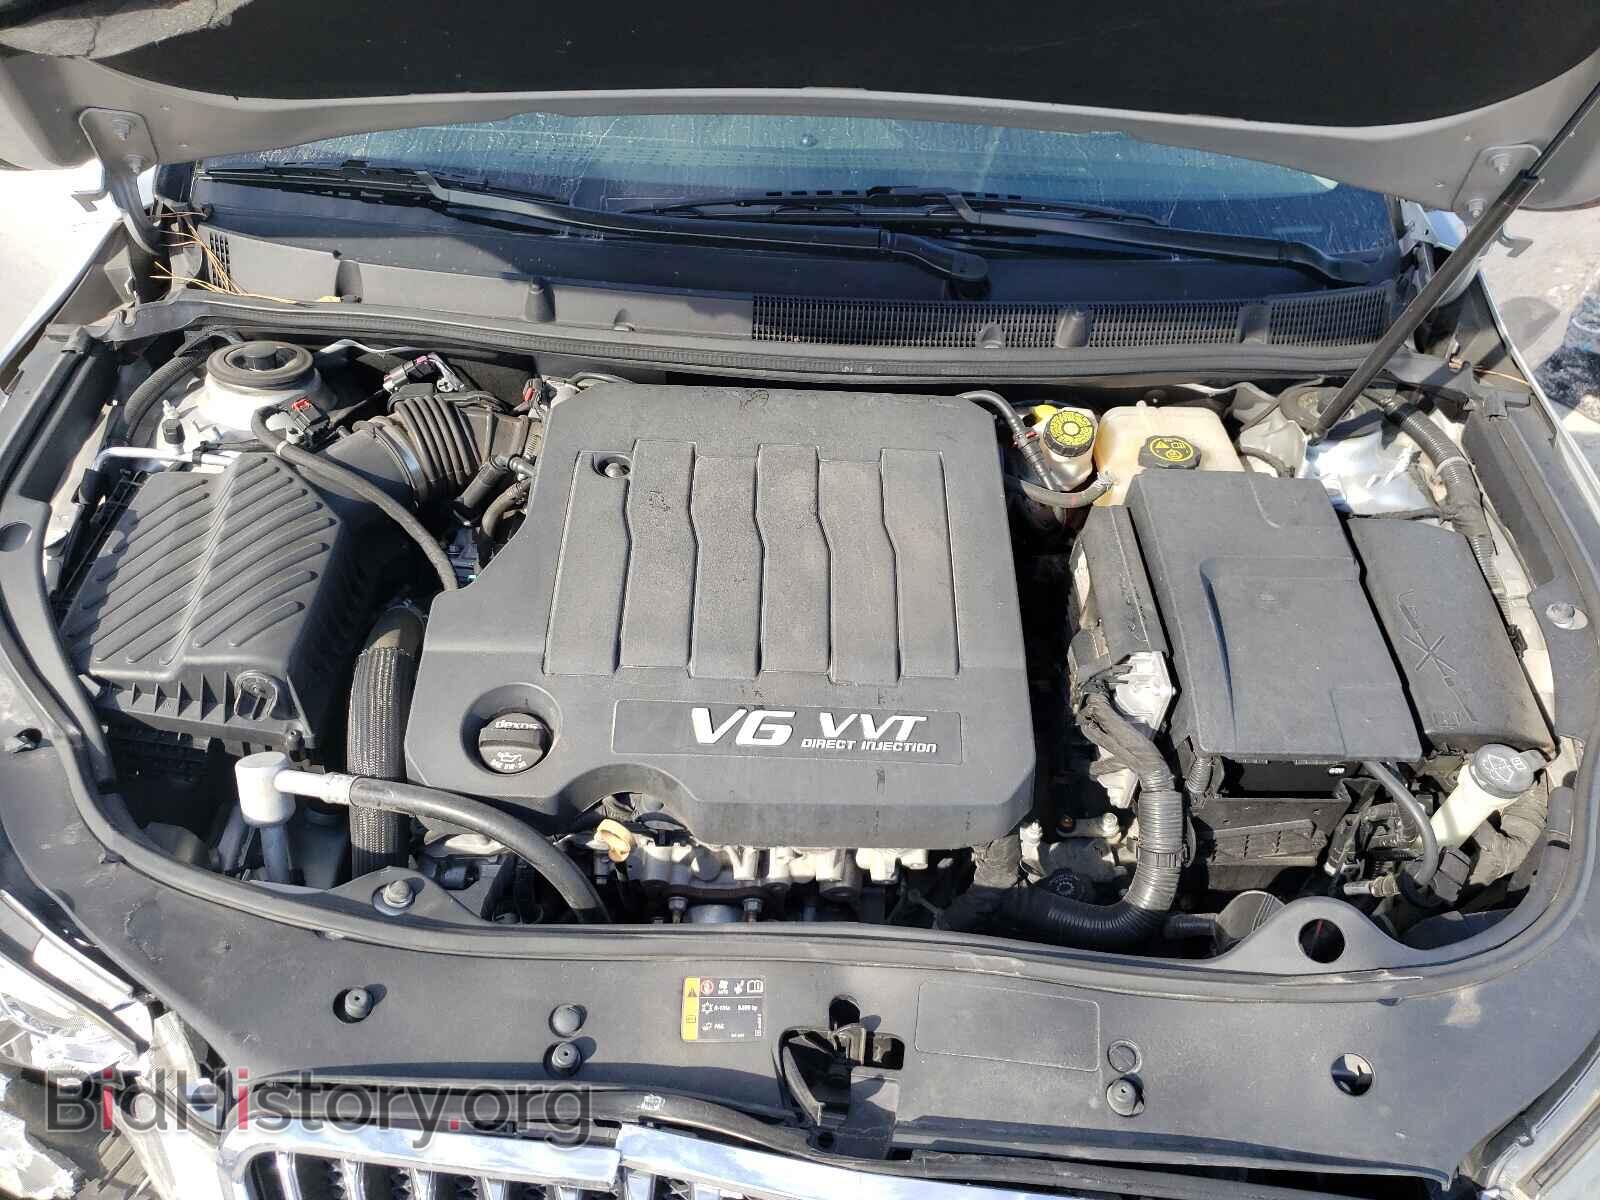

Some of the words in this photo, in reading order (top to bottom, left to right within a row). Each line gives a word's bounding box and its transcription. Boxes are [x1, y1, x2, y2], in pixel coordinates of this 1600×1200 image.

[691, 706, 796, 746] V6
[819, 711, 928, 741] VVT
[800, 737, 857, 750] DIRECT
[861, 740, 938, 753] INJECTION
